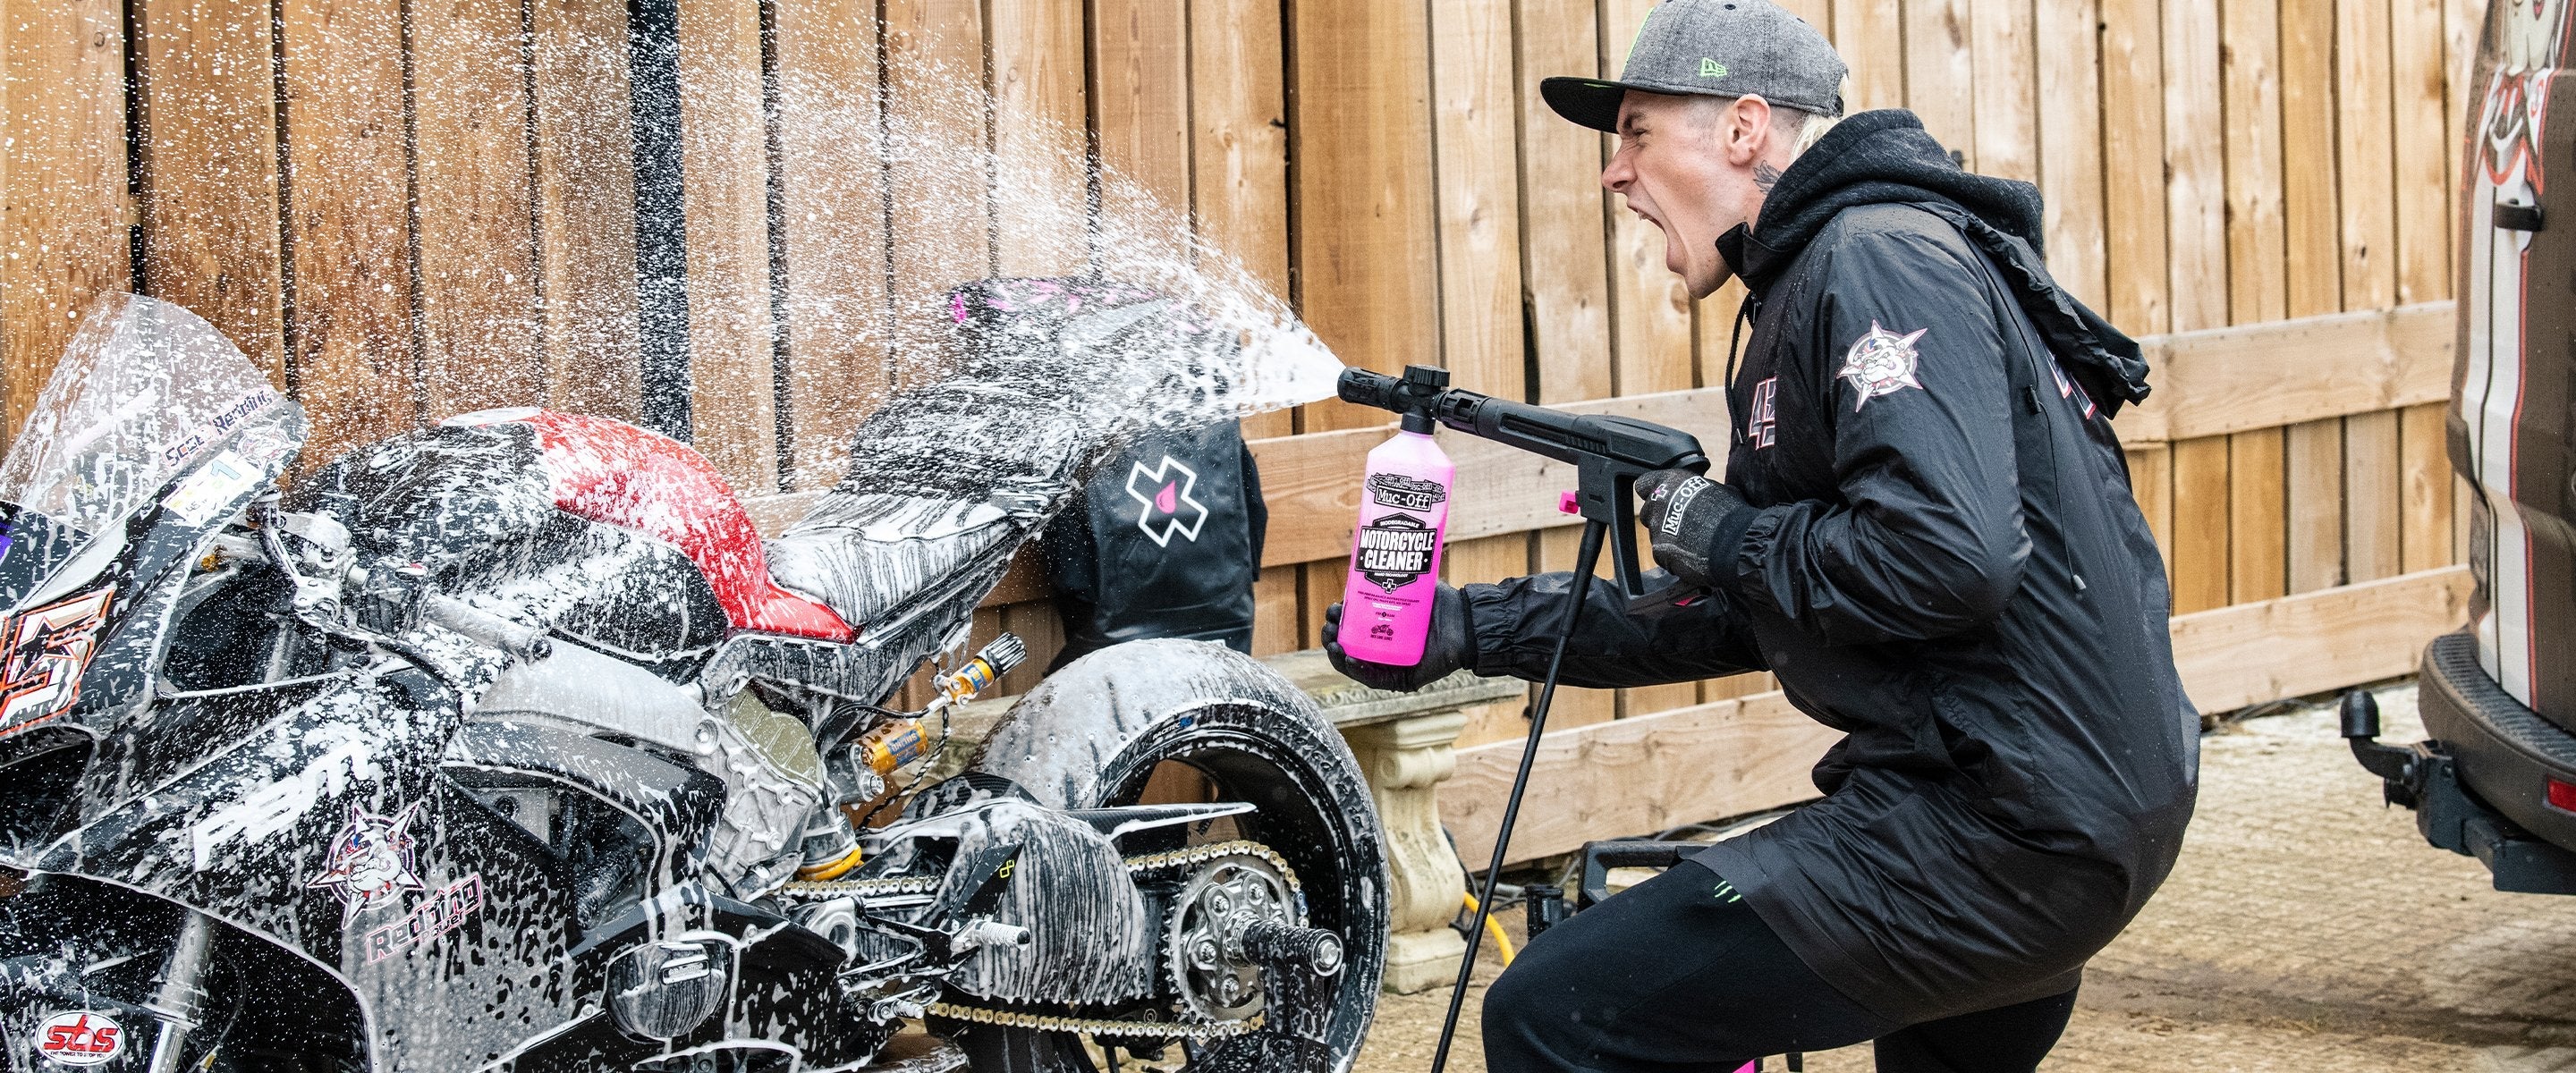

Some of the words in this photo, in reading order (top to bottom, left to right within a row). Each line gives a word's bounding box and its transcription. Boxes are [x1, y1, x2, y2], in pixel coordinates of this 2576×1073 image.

[1377, 488, 1430, 509] Muc-Off
[1665, 476, 1707, 533] Muc-Off
[1360, 528, 1436, 552] MOTORCYCLE
[1364, 548, 1424, 571] CLEANER
[43, 1014, 119, 1053] sbs
